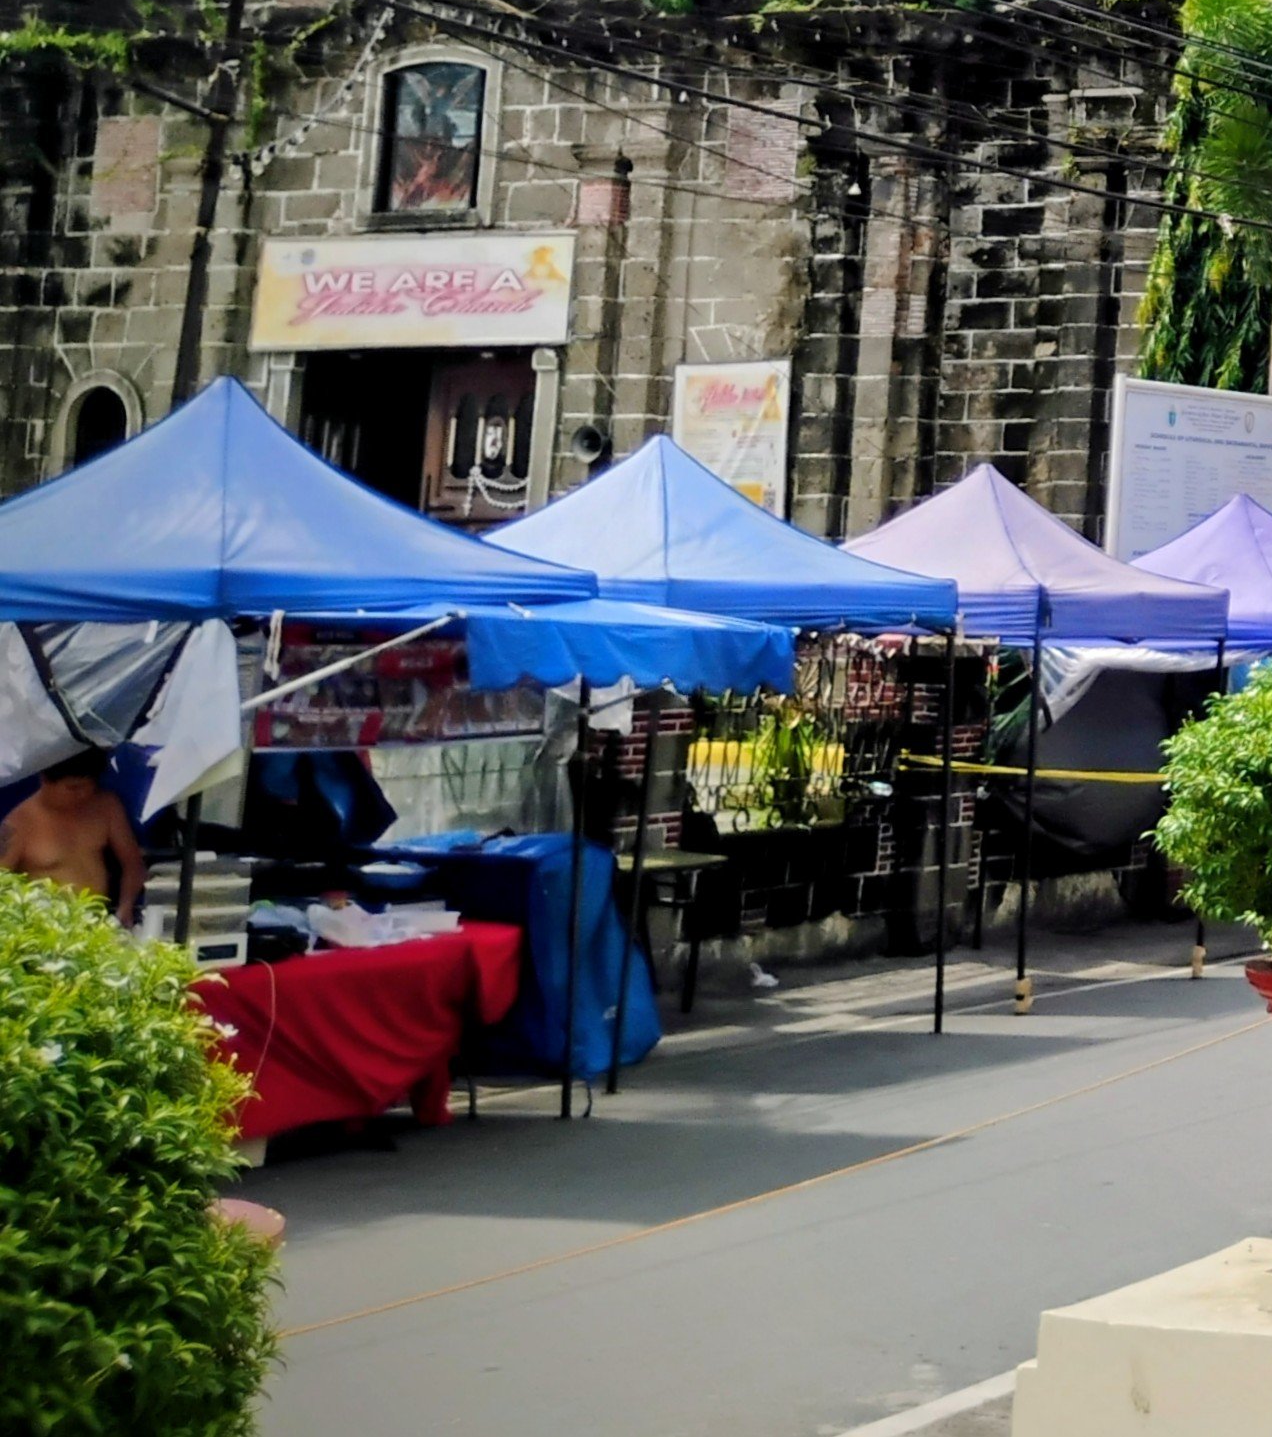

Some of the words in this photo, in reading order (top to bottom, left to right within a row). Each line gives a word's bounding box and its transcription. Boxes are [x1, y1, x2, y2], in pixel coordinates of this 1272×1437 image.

[304, 271, 375, 294] WE
[391, 270, 476, 293] ARE
[490, 268, 524, 292] A
